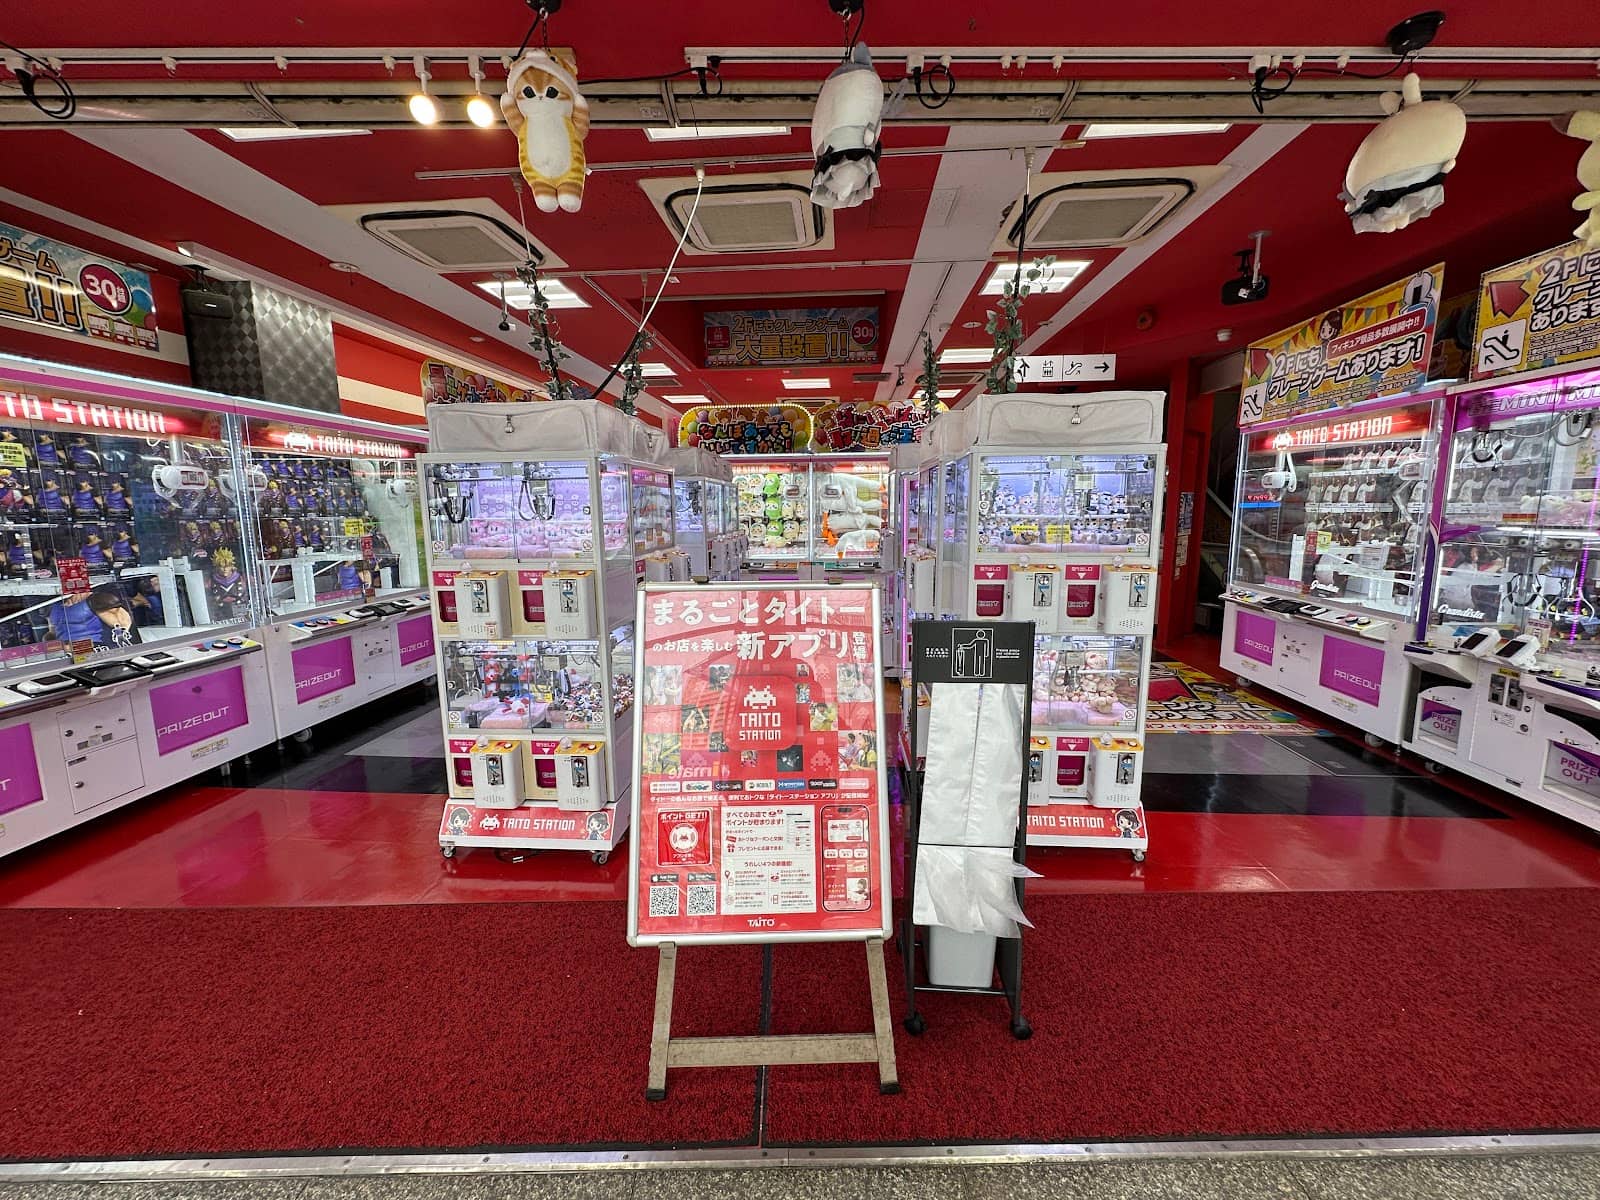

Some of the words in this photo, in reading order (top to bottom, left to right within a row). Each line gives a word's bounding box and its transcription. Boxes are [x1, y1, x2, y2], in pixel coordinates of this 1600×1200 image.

[85, 274, 118, 299] 30
[733, 315, 849, 334] 2Fにもクレーンゲーム
[853, 326, 869, 338] 30
[736, 333, 848, 361] 大量設置!!
[1268, 334, 1426, 399] クレーンゲームあります!
[1272, 347, 1322, 377] 2Fにも
[51, 397, 166, 434] STATION
[699, 423, 793, 440] なんぼあっても
[1296, 427, 1327, 444] TAITO
[1332, 416, 1393, 442] STATION
[316, 434, 354, 454] TAITO
[357, 440, 402, 458] STATION
[652, 597, 866, 626] まるごとタイトー
[652, 640, 733, 653] のお店を楽しむ
[737, 629, 849, 660] 新アプリ
[852, 631, 868, 660] 登場
[295, 669, 342, 690] PRIZEOUT
[157, 706, 229, 737] PRIZEOUT
[739, 712, 781, 728] TAITO
[1432, 711, 1457, 727] PRIZE
[1433, 721, 1454, 734] OUT
[739, 730, 781, 741] STATION
[1560, 757, 1597, 776] PRIZE
[1562, 769, 1592, 784] OUT
[503, 817, 529, 829] TAITO
[533, 819, 575, 831] STATION
[1027, 815, 1056, 827] TAITO
[1059, 815, 1104, 828] STATION
[747, 916, 775, 928] TAITO
